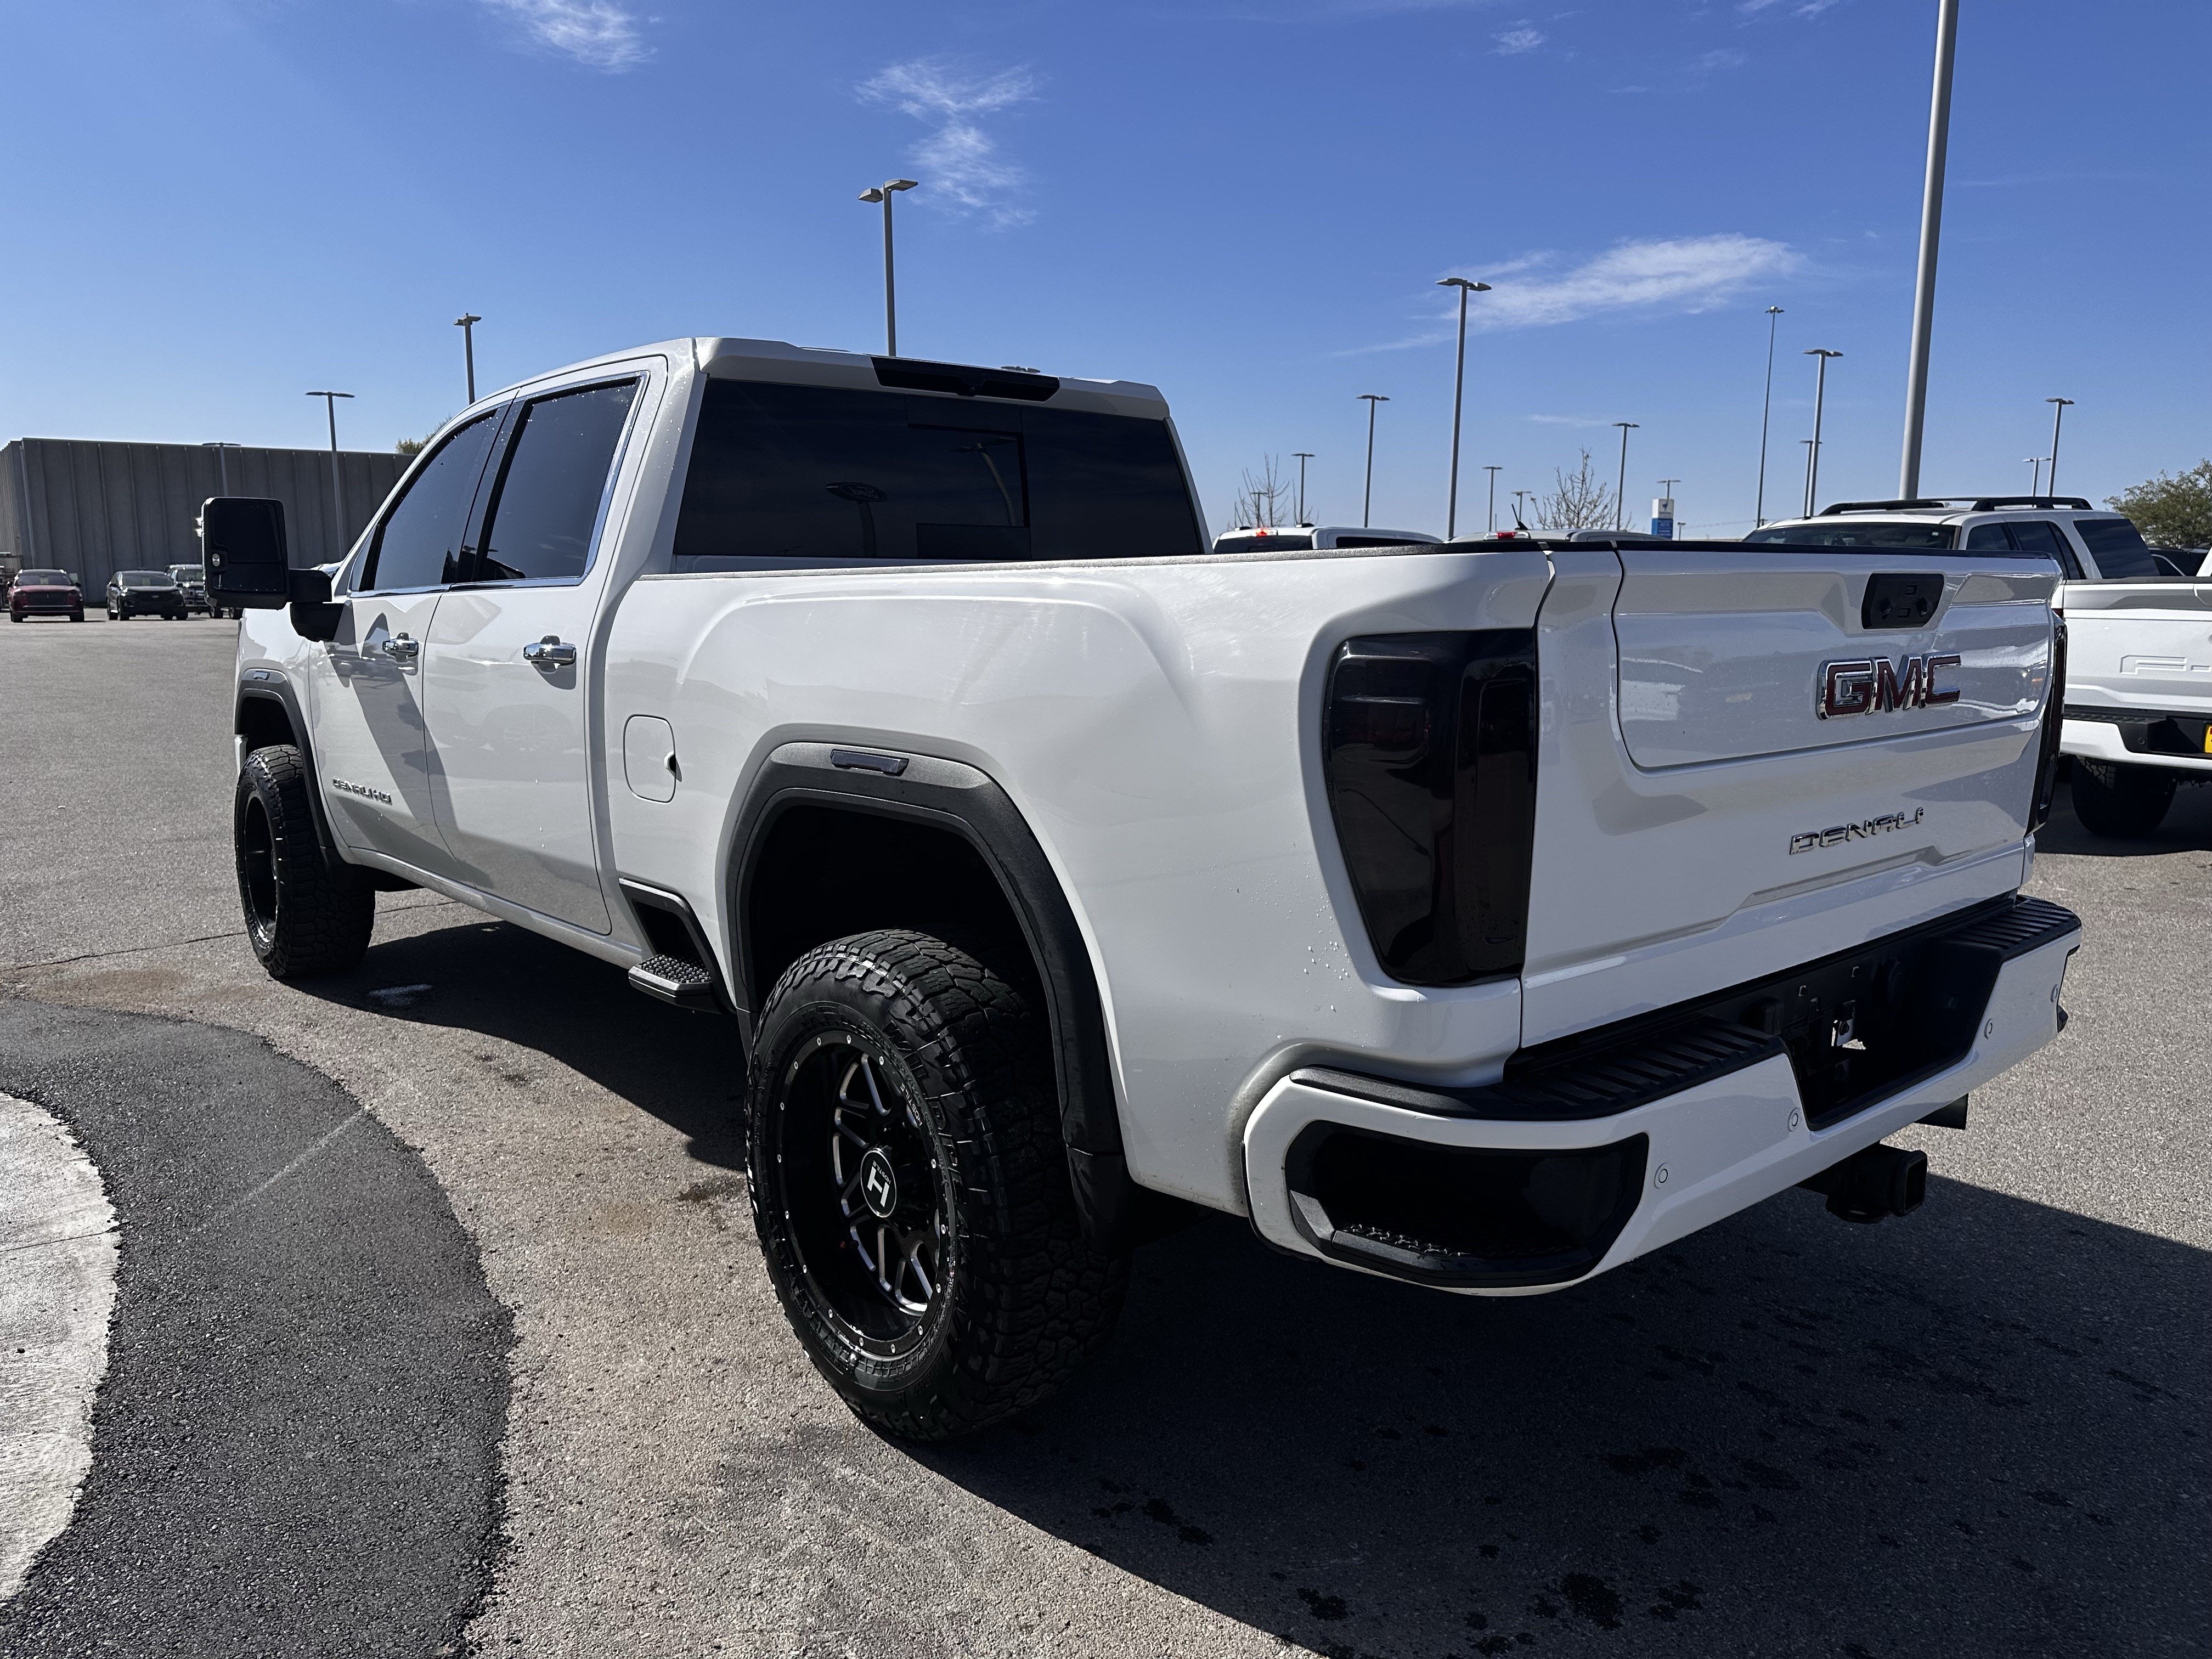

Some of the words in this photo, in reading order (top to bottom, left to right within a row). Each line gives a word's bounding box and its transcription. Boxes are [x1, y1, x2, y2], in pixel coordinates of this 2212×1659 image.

[1816, 651, 1961, 720] GMC
[332, 778, 374, 800] DENALI
[1790, 807, 1923, 855] DENALI
[900, 1082, 923, 1126] HOSTILE
[873, 1160, 891, 1185] HOSTILE
